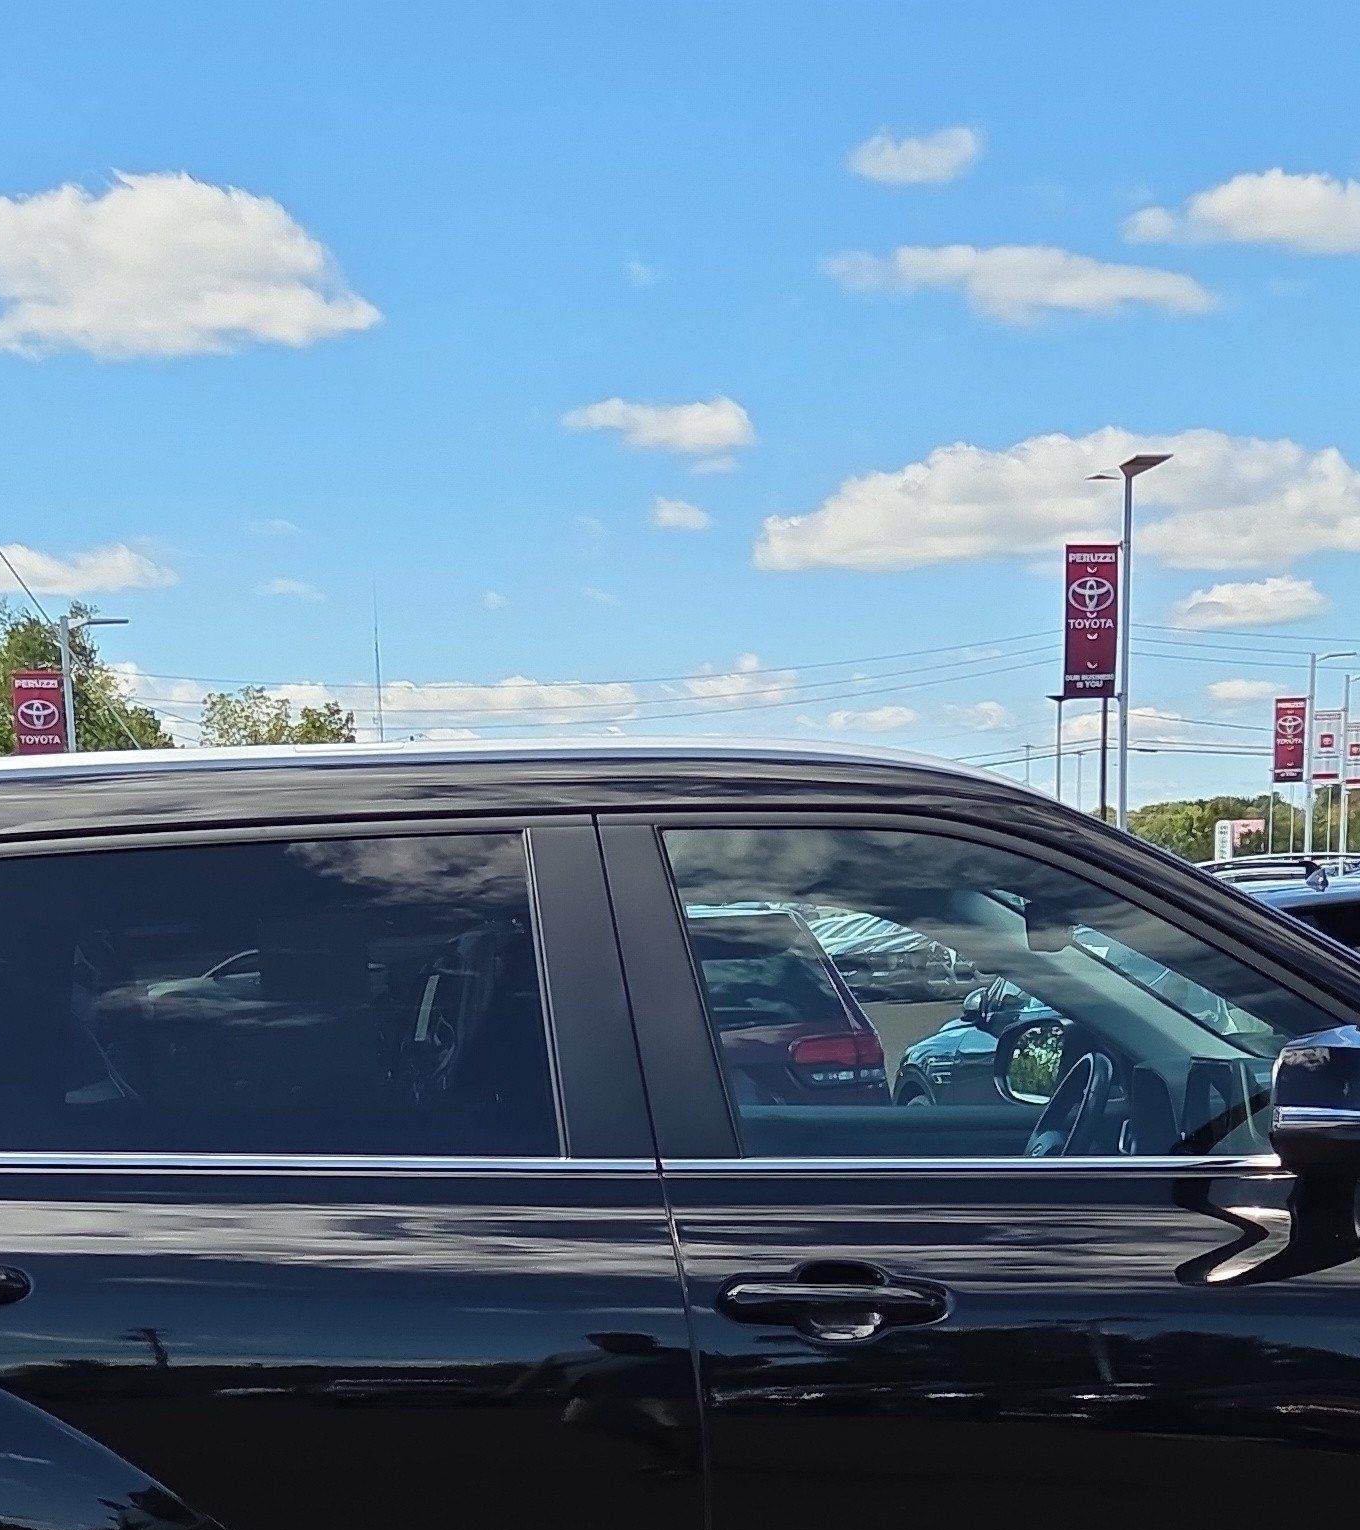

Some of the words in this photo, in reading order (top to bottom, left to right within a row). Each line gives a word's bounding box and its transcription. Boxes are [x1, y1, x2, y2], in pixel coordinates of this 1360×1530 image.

[1068, 619, 1114, 629] TOYOTA
[1085, 681, 1104, 689] YOU
[19, 735, 61, 744] TOYOTA
